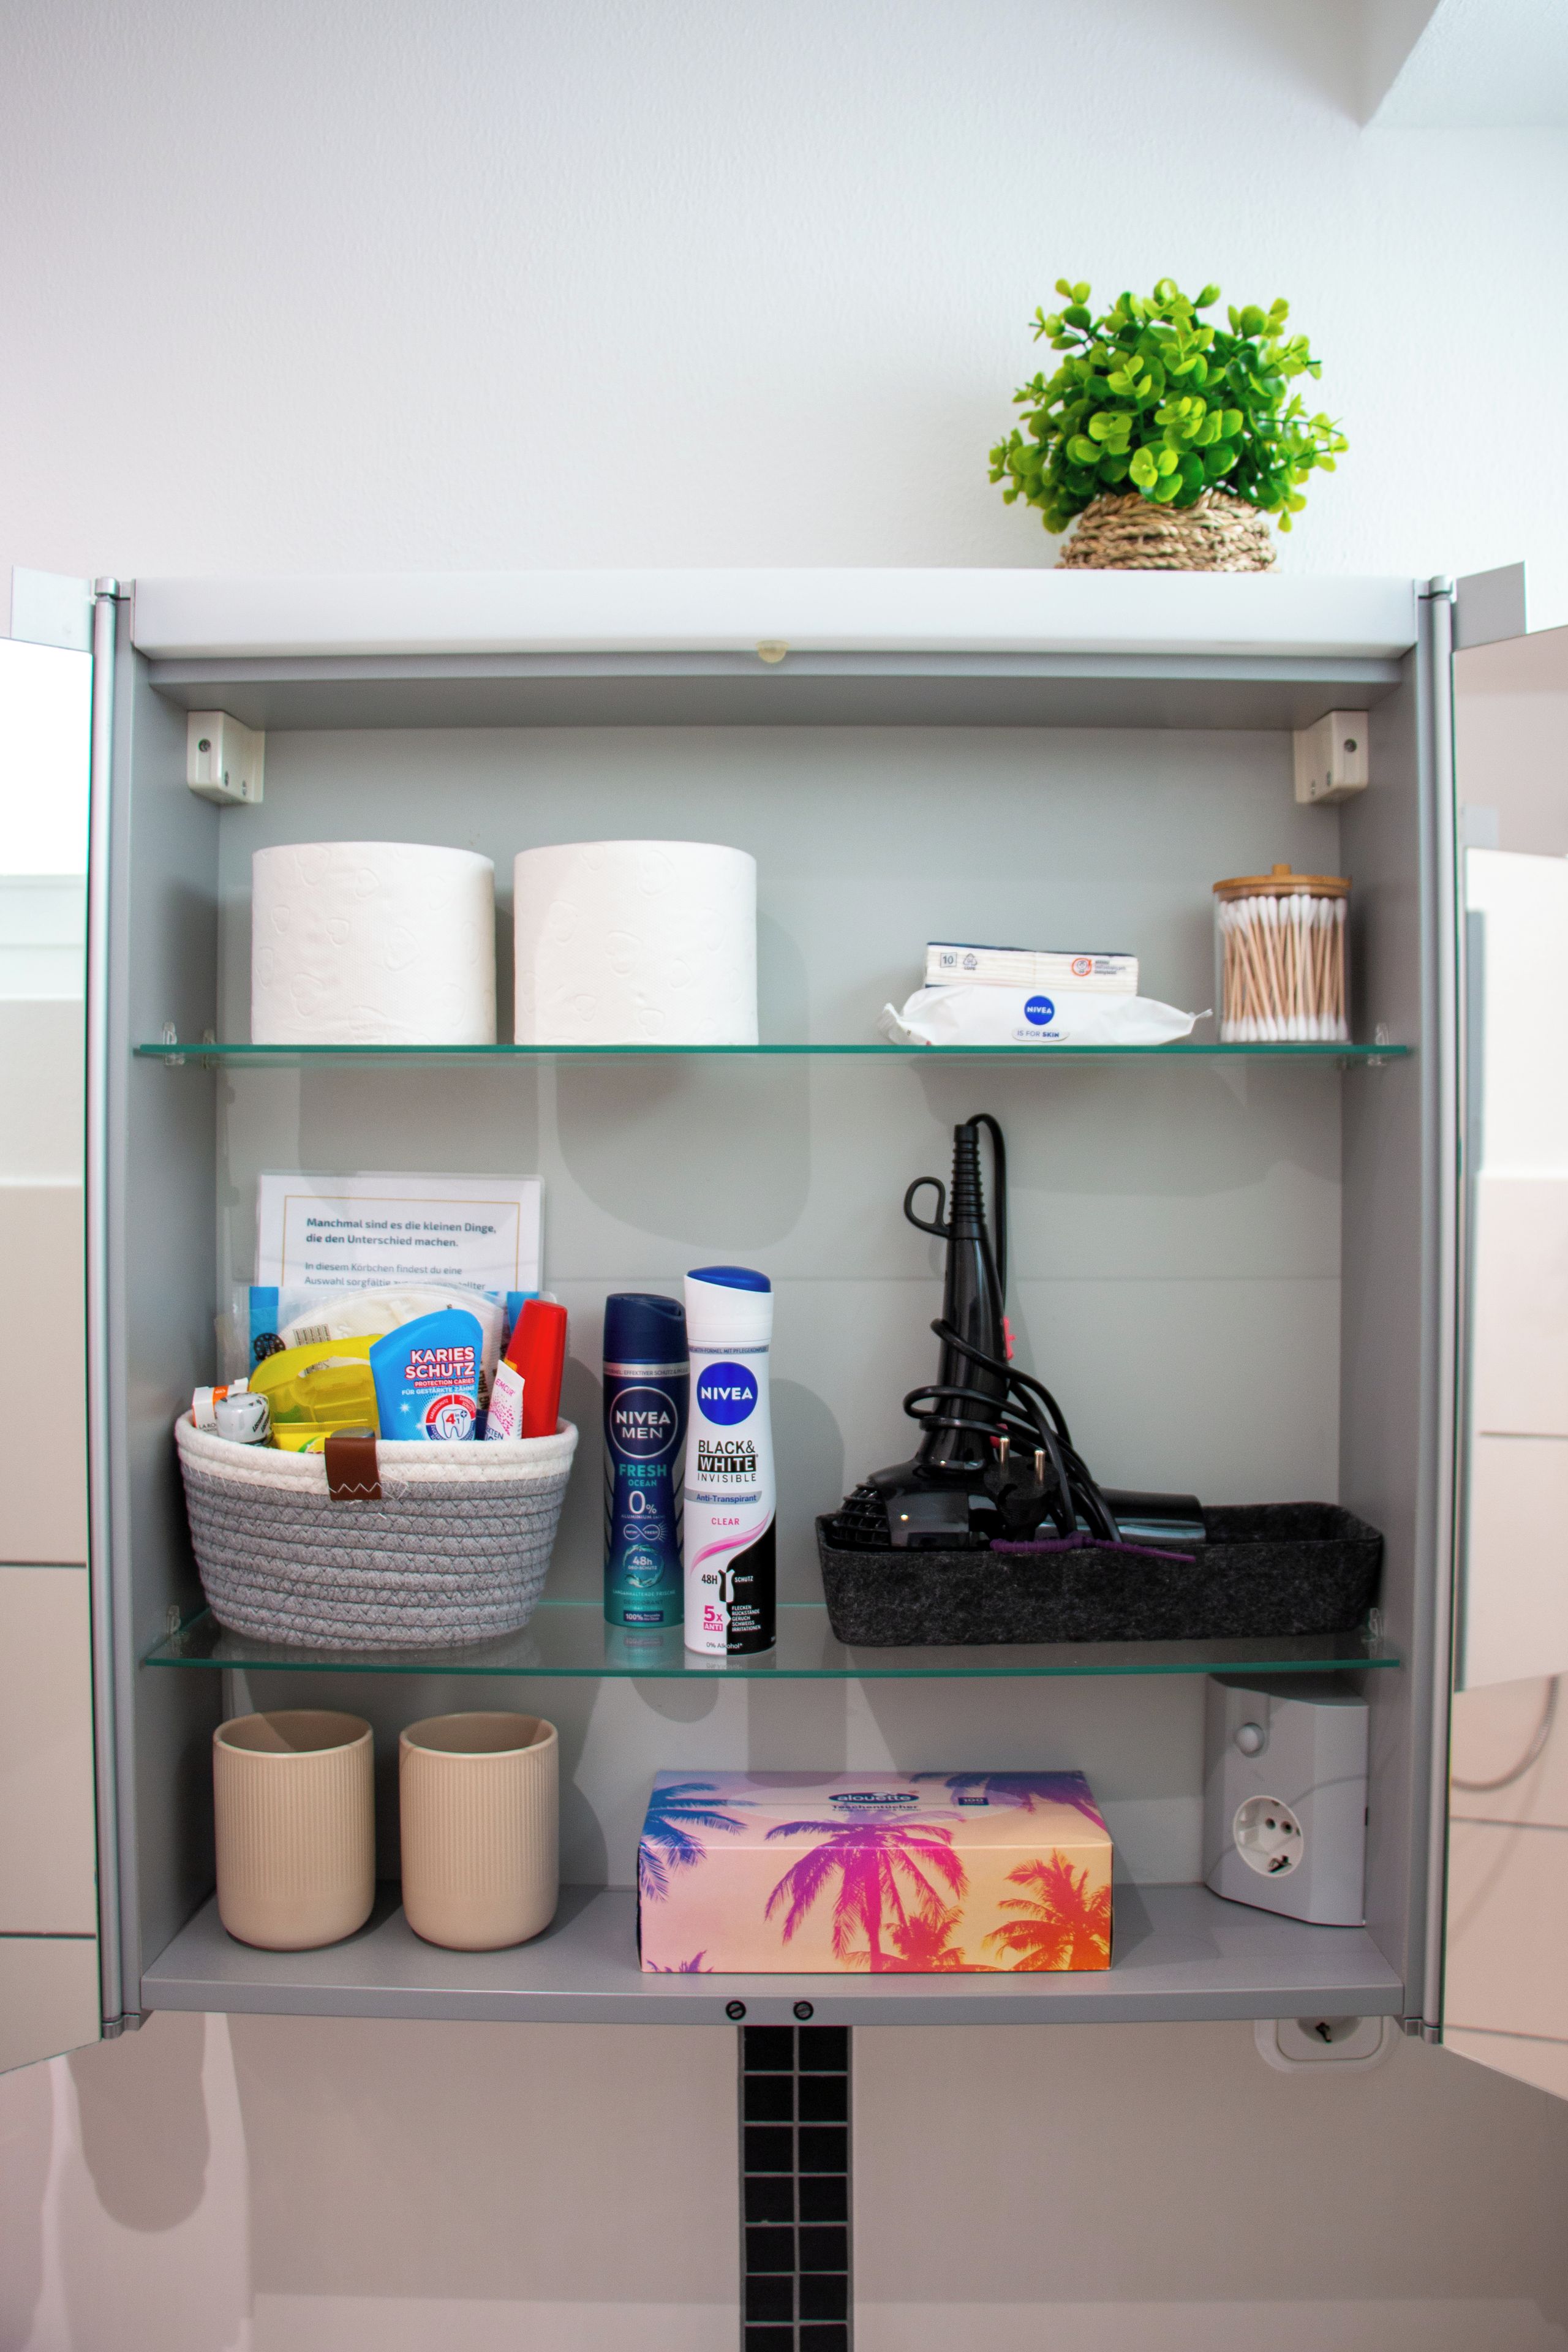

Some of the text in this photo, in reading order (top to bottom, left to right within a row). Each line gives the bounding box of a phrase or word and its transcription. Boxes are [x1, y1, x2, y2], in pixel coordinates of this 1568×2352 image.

[943, 956, 954, 964] 10
[306, 1218, 363, 1228] Manchmal
[365, 1220, 387, 1229] sind
[405, 1221, 421, 1230] die
[423, 1221, 461, 1231] kleinen
[465, 1223, 496, 1234] Dinge,
[306, 1234, 322, 1242] die
[348, 1235, 412, 1245] Unterschied
[415, 1238, 458, 1246] machen.
[316, 1262, 348, 1271] diesem
[351, 1264, 394, 1272] Körbchen
[397, 1264, 428, 1273] findest
[431, 1265, 441, 1274] du
[304, 1276, 344, 1285] Auswahl
[411, 1346, 475, 1364] KARIES
[405, 1362, 475, 1379] SCHUTZ
[701, 1386, 753, 1400] NIVEA
[446, 1413, 456, 1424] 4
[616, 1410, 671, 1425] NIVEA
[622, 1427, 662, 1438] MEN
[698, 1439, 755, 1454] BLACK&
[619, 1463, 667, 1477] FRESH
[700, 1456, 754, 1472] WHITE
[698, 1473, 756, 1483] INVISIBLE
[629, 1490, 657, 1514] 0%
[696, 1493, 756, 1504] Anti-Transpirant
[633, 1556, 652, 1566] 48h
[701, 1574, 717, 1585] 48H
